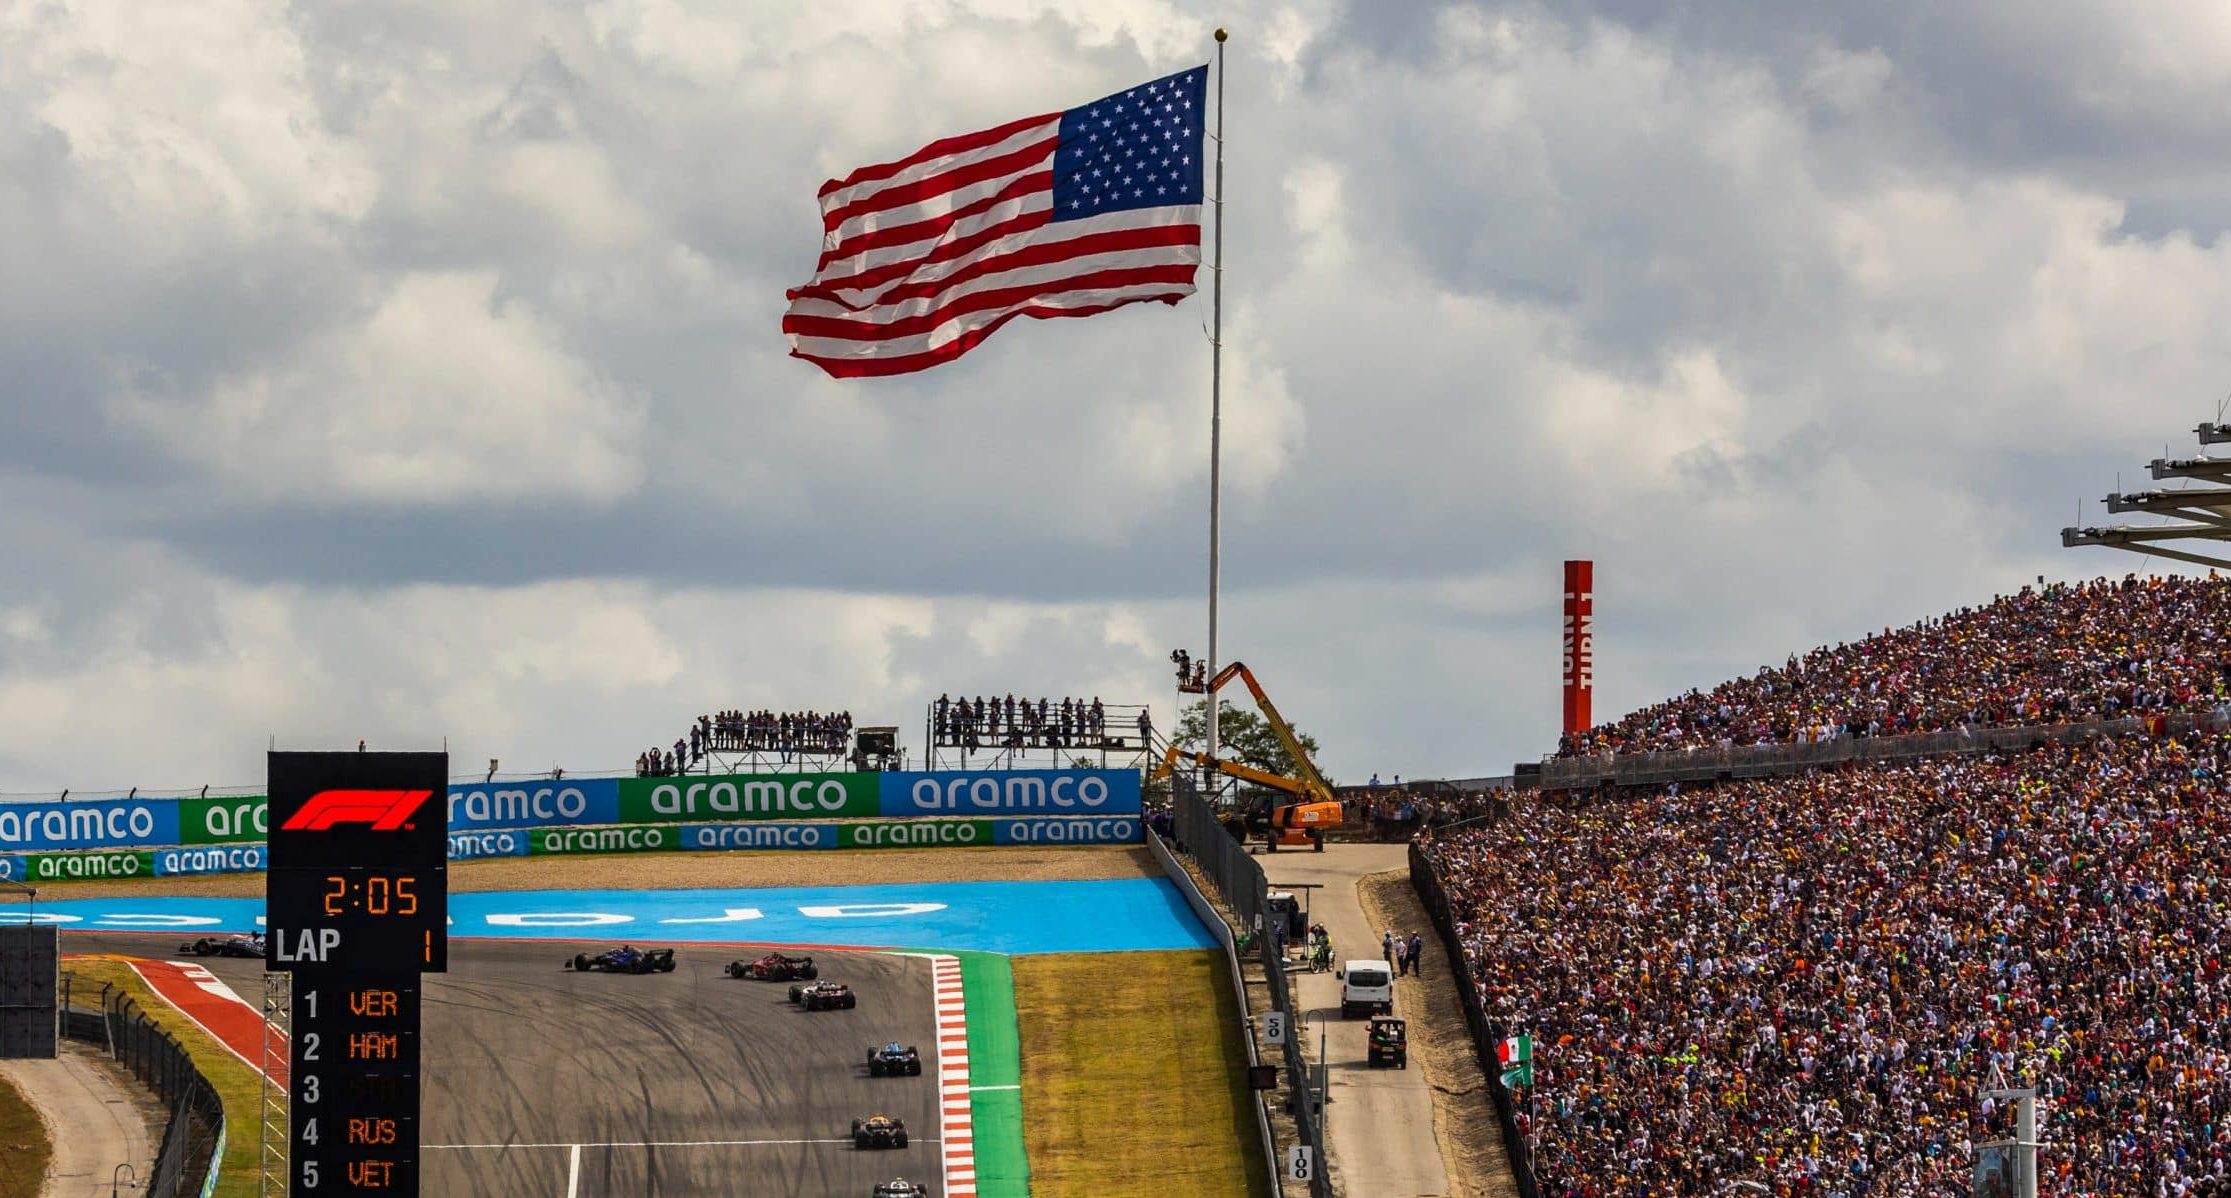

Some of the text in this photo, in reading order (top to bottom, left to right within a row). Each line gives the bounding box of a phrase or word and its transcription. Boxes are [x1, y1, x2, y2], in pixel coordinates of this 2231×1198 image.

[448, 788, 586, 823] ramco
[651, 780, 847, 814] aramco
[912, 777, 1108, 809] aramco
[0, 807, 153, 841] aramco
[281, 790, 434, 830] F1
[544, 829, 662, 851] aramco
[698, 826, 819, 846] aramco
[854, 823, 976, 844] aramco
[1010, 820, 1132, 841] aramco
[39, 855, 139, 877] aramco
[165, 849, 259, 872] aramco
[325, 877, 417, 914] 2:05
[277, 929, 430, 962] LAP 1
[303, 990, 397, 1018] 1 VER
[1268, 1018, 1279, 1038] 50
[303, 1033, 397, 1061] 2 HAM
[303, 1075, 319, 1103] 3
[302, 1118, 396, 1145] 4 RUS
[303, 1161, 394, 1188] 5 VET
[1295, 1148, 1307, 1179] 100
